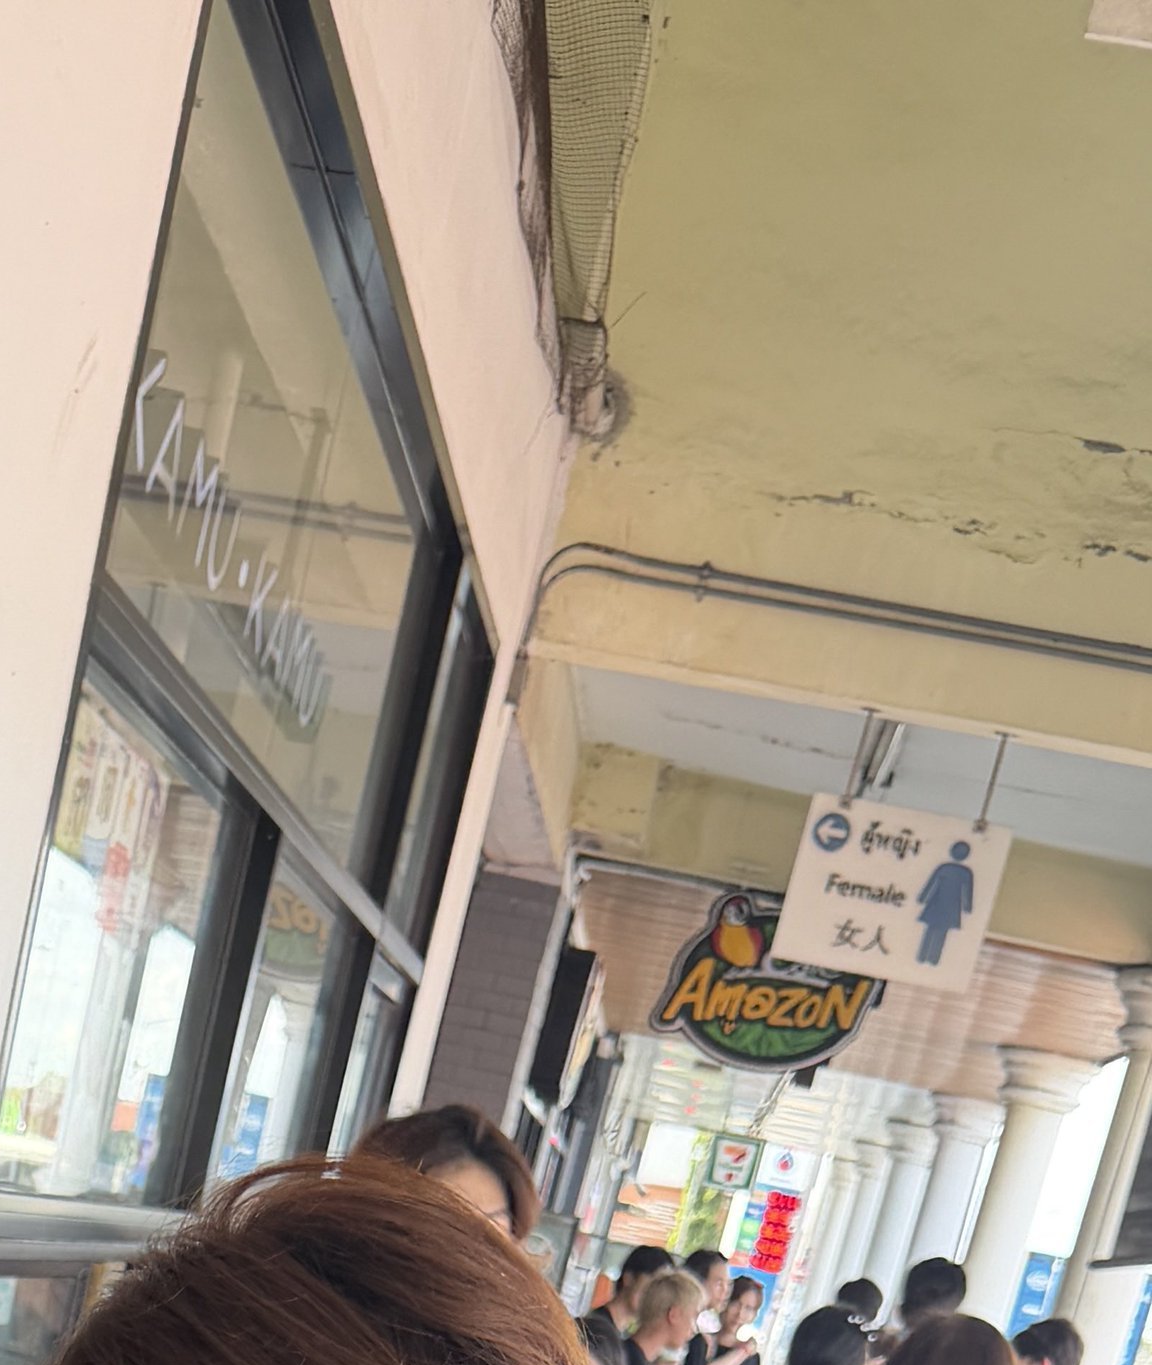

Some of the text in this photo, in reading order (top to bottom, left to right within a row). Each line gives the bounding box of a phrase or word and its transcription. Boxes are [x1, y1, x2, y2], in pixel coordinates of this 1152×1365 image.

[860, 821, 921, 859] ผู้หญิง
[824, 873, 907, 907] Female
[832, 919, 889, 954] 女人
